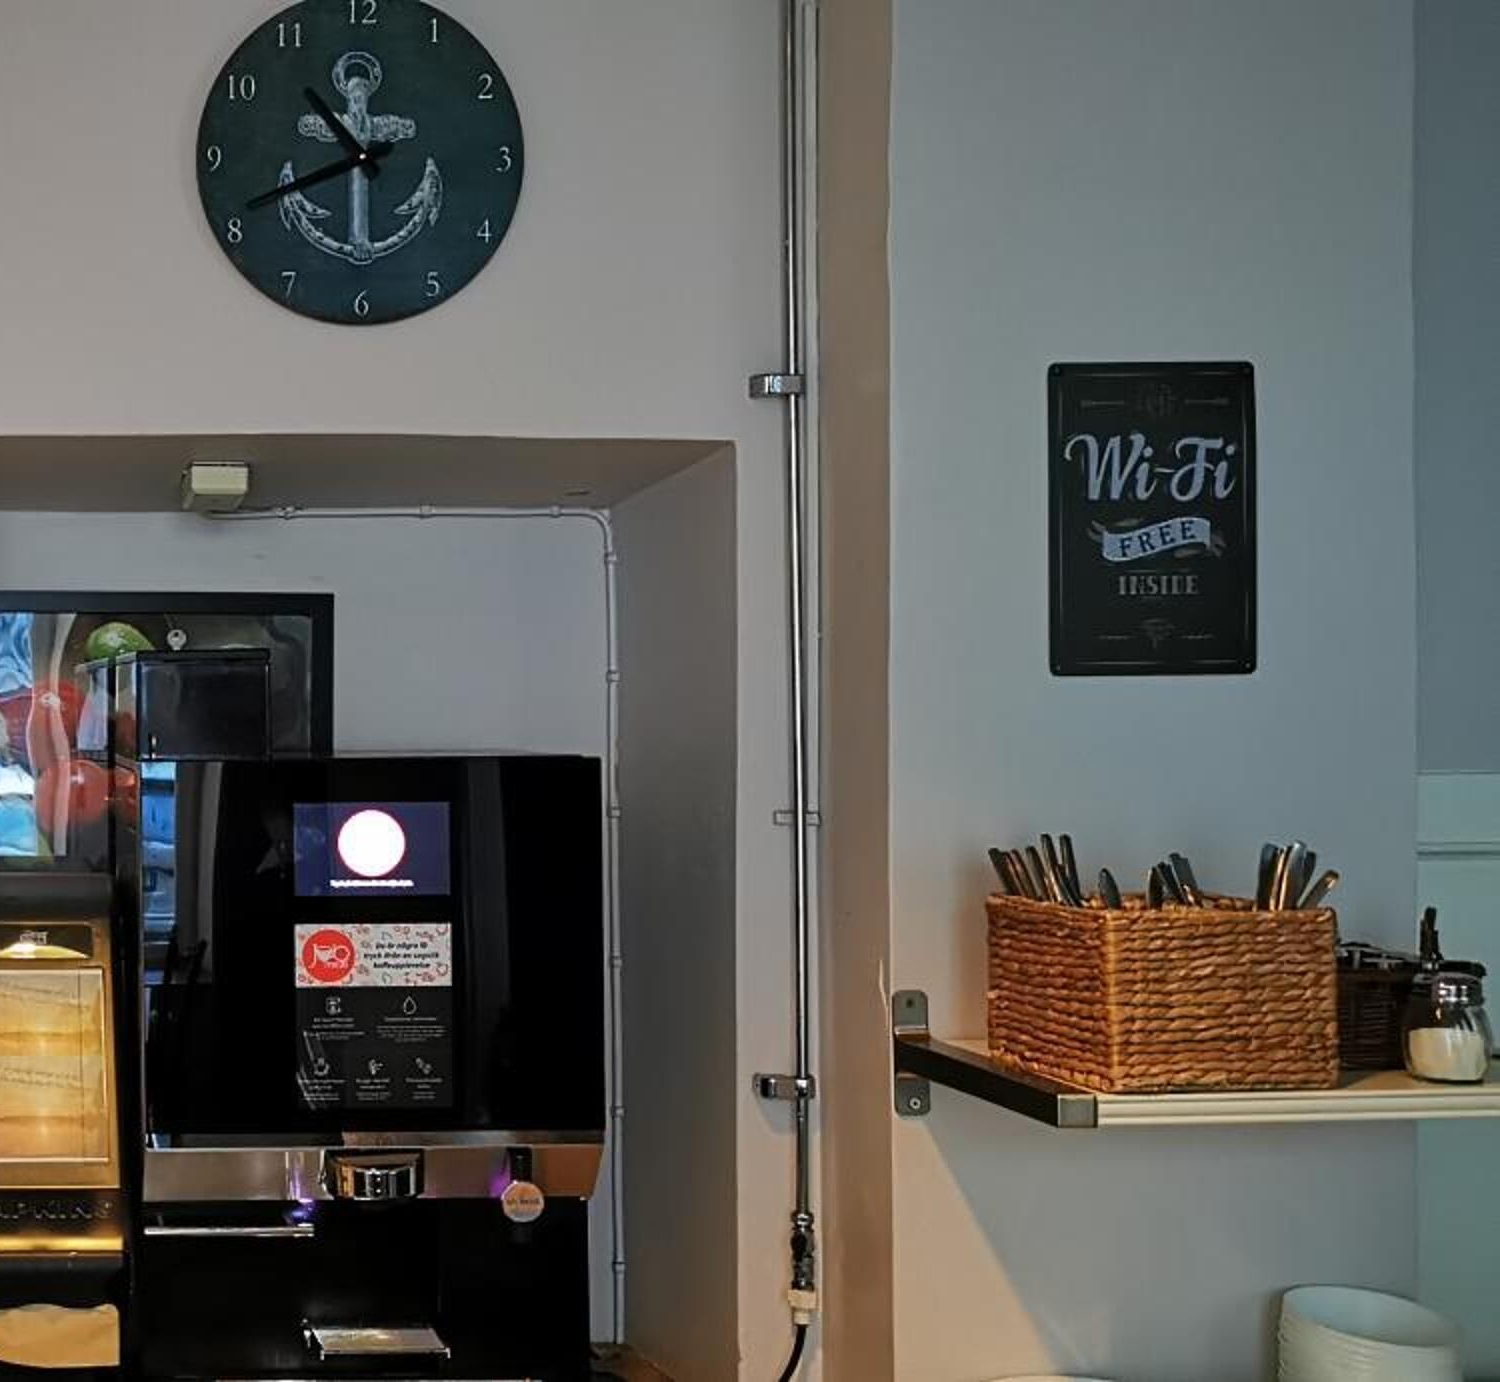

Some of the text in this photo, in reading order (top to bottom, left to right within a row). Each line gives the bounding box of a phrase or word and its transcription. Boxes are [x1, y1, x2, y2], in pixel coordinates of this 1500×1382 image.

[348, 0, 378, 24] 12
[277, 22, 302, 47] 11
[429, 18, 439, 43] 1
[227, 74, 256, 101] 10
[477, 74, 494, 100] 2
[206, 145, 222, 172] 9
[496, 146, 512, 173] 3
[227, 218, 243, 244] 8
[477, 218, 493, 244] 4
[281, 271, 297, 295] 7
[426, 271, 441, 297] 5
[354, 290, 370, 316] 6
[1065, 431, 1237, 502] Wi-Fi
[1118, 519, 1198, 558] FREE
[1117, 574, 1201, 596] INSIDE
